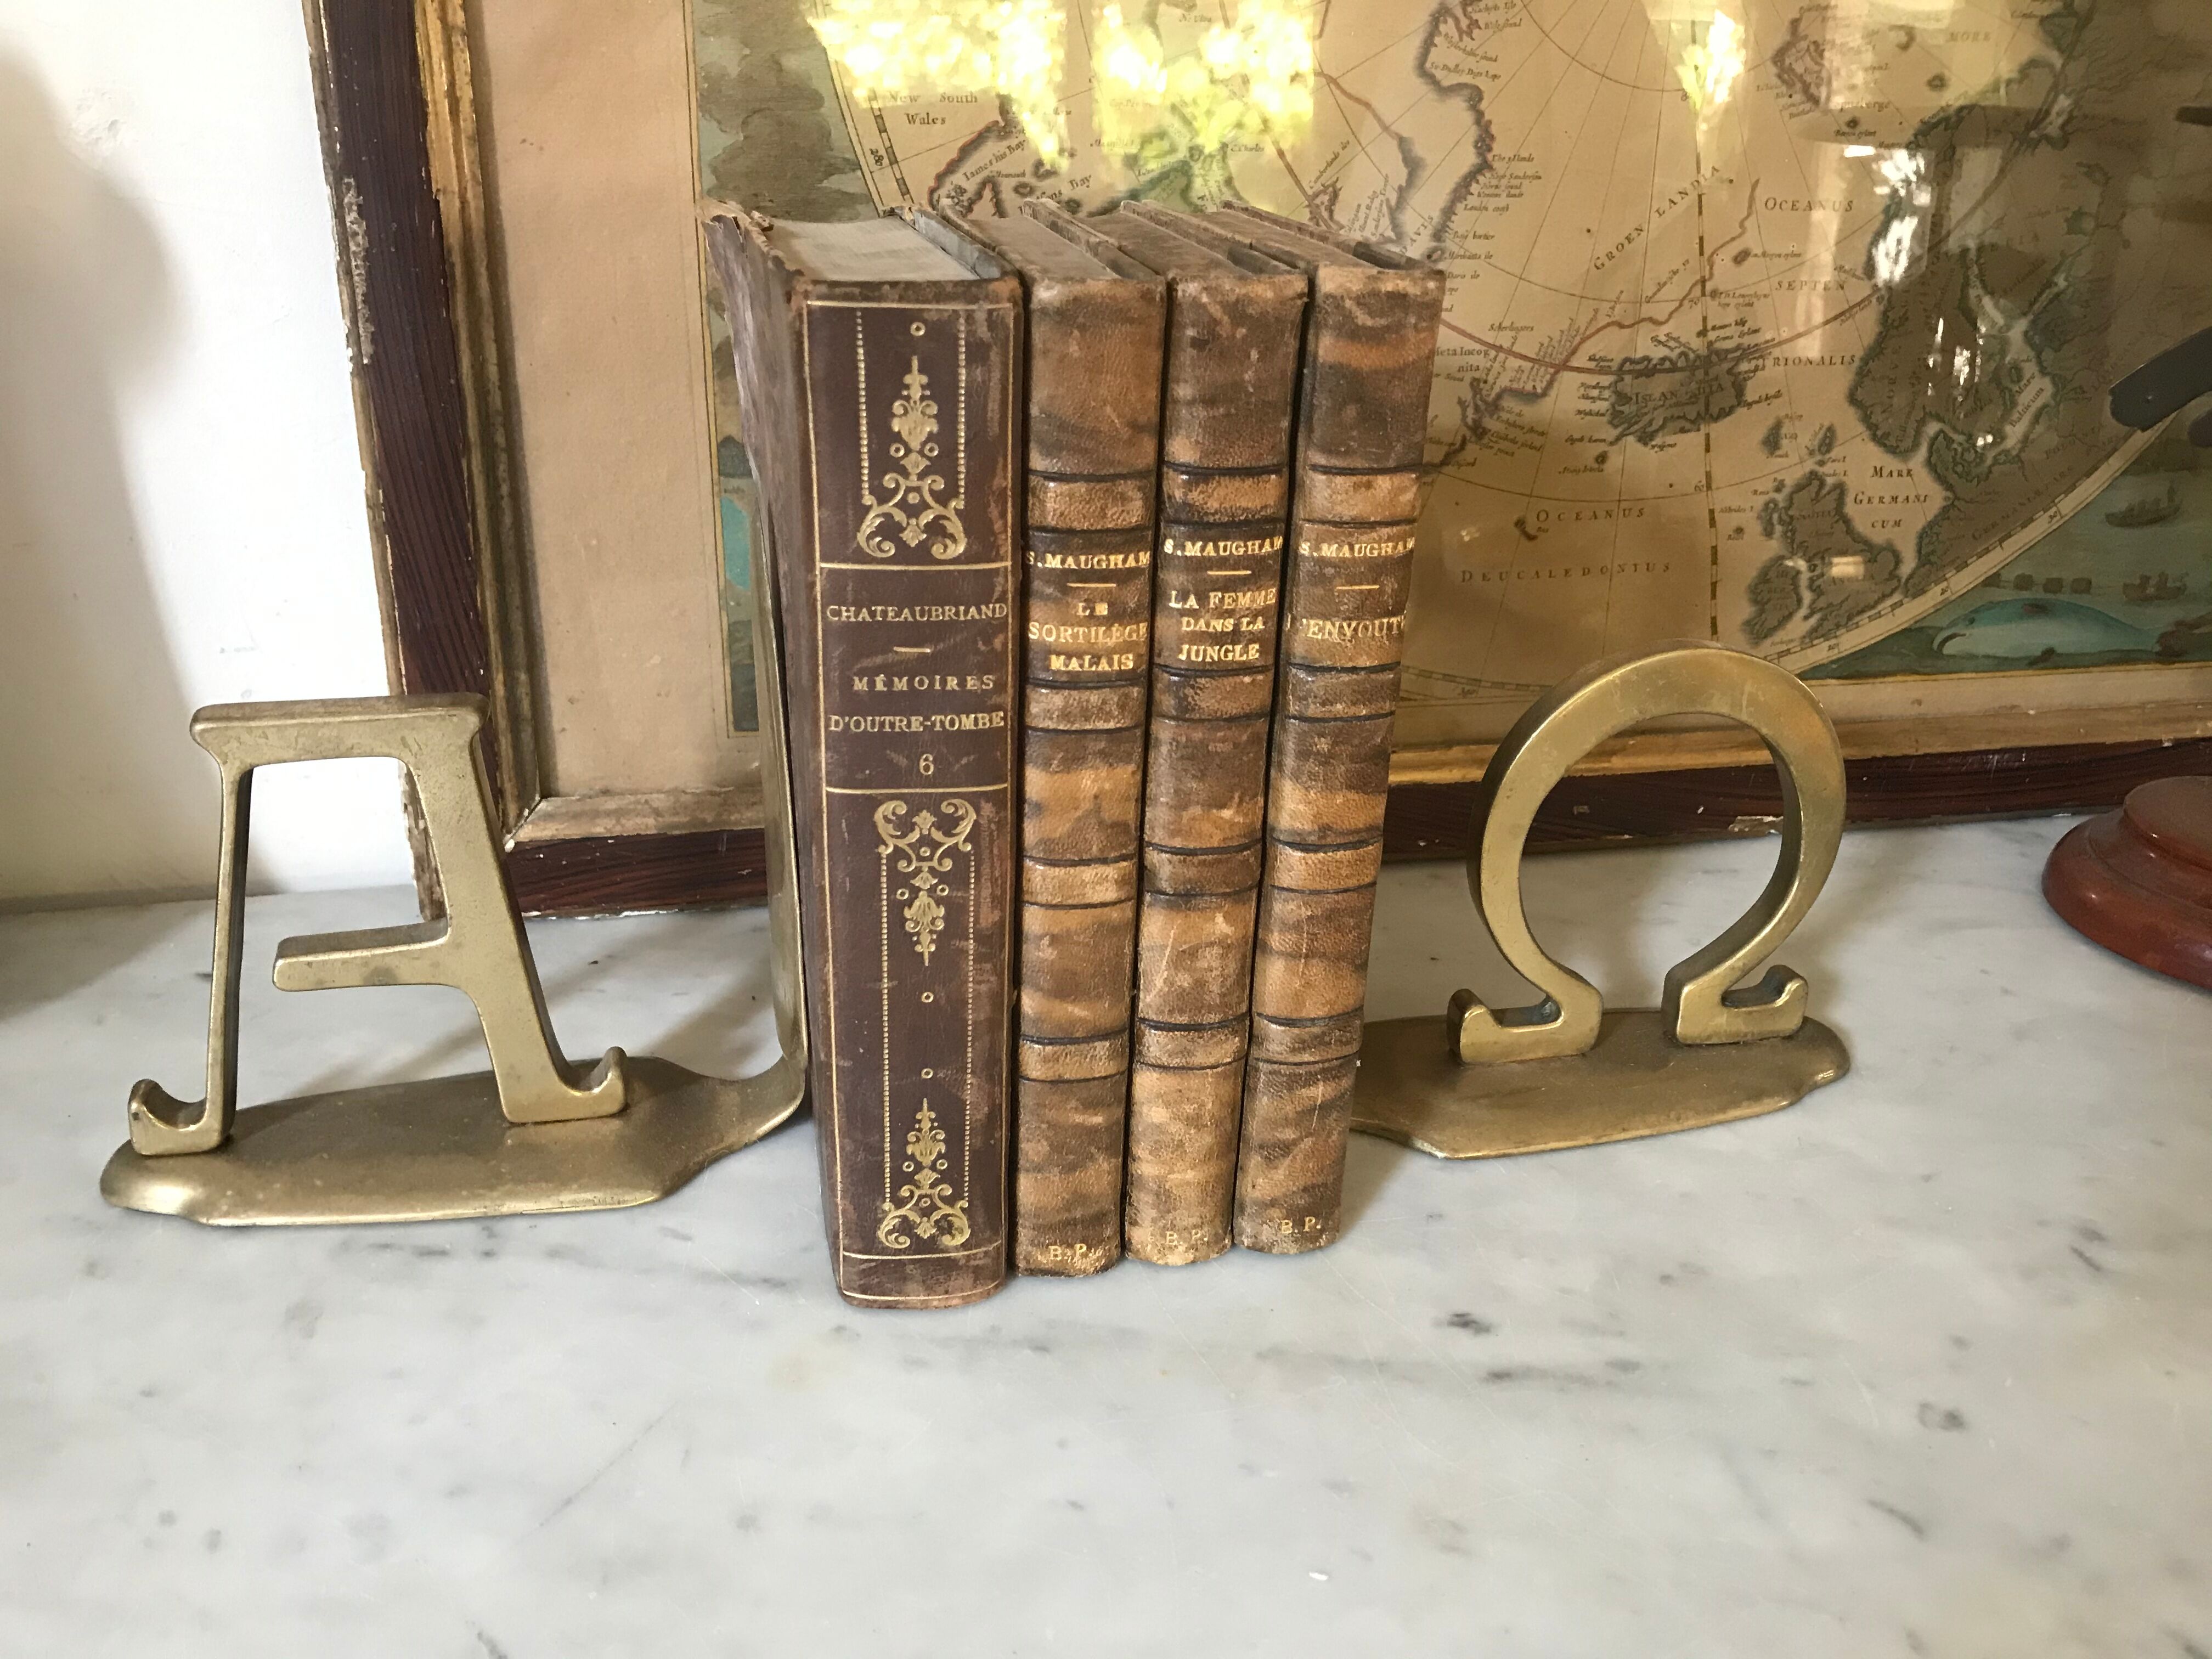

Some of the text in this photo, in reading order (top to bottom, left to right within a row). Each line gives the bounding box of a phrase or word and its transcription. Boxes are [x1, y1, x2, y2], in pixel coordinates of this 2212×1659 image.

[889, 91, 978, 103] New South
[904, 112, 946, 125] Wales
[1764, 196, 1855, 213] OCEANUS
[1593, 164, 1721, 271] GROEN LANDIA
[1775, 279, 1847, 292] SEPTEN
[1435, 346, 1491, 358] eta Incog
[1457, 362, 1481, 373] nita
[1536, 507, 1646, 523] OCEANUS
[1871, 518, 1903, 529] CUM
[1164, 534, 1283, 556] S.MAUGHAM
[1461, 561, 1672, 583] DEUCALEDONIUS
[1169, 587, 1277, 610] LA FEMME
[826, 602, 1007, 622] CHATEAUBRIAND
[1181, 614, 1265, 633] DANS LA
[1049, 653, 1135, 672] MALAIS
[1177, 643, 1260, 663] JUNGLE
[853, 673, 997, 692] MÉMOIRES
[828, 710, 1005, 732] D'OUTRE-TOMBE
[918, 753, 934, 776] 6
